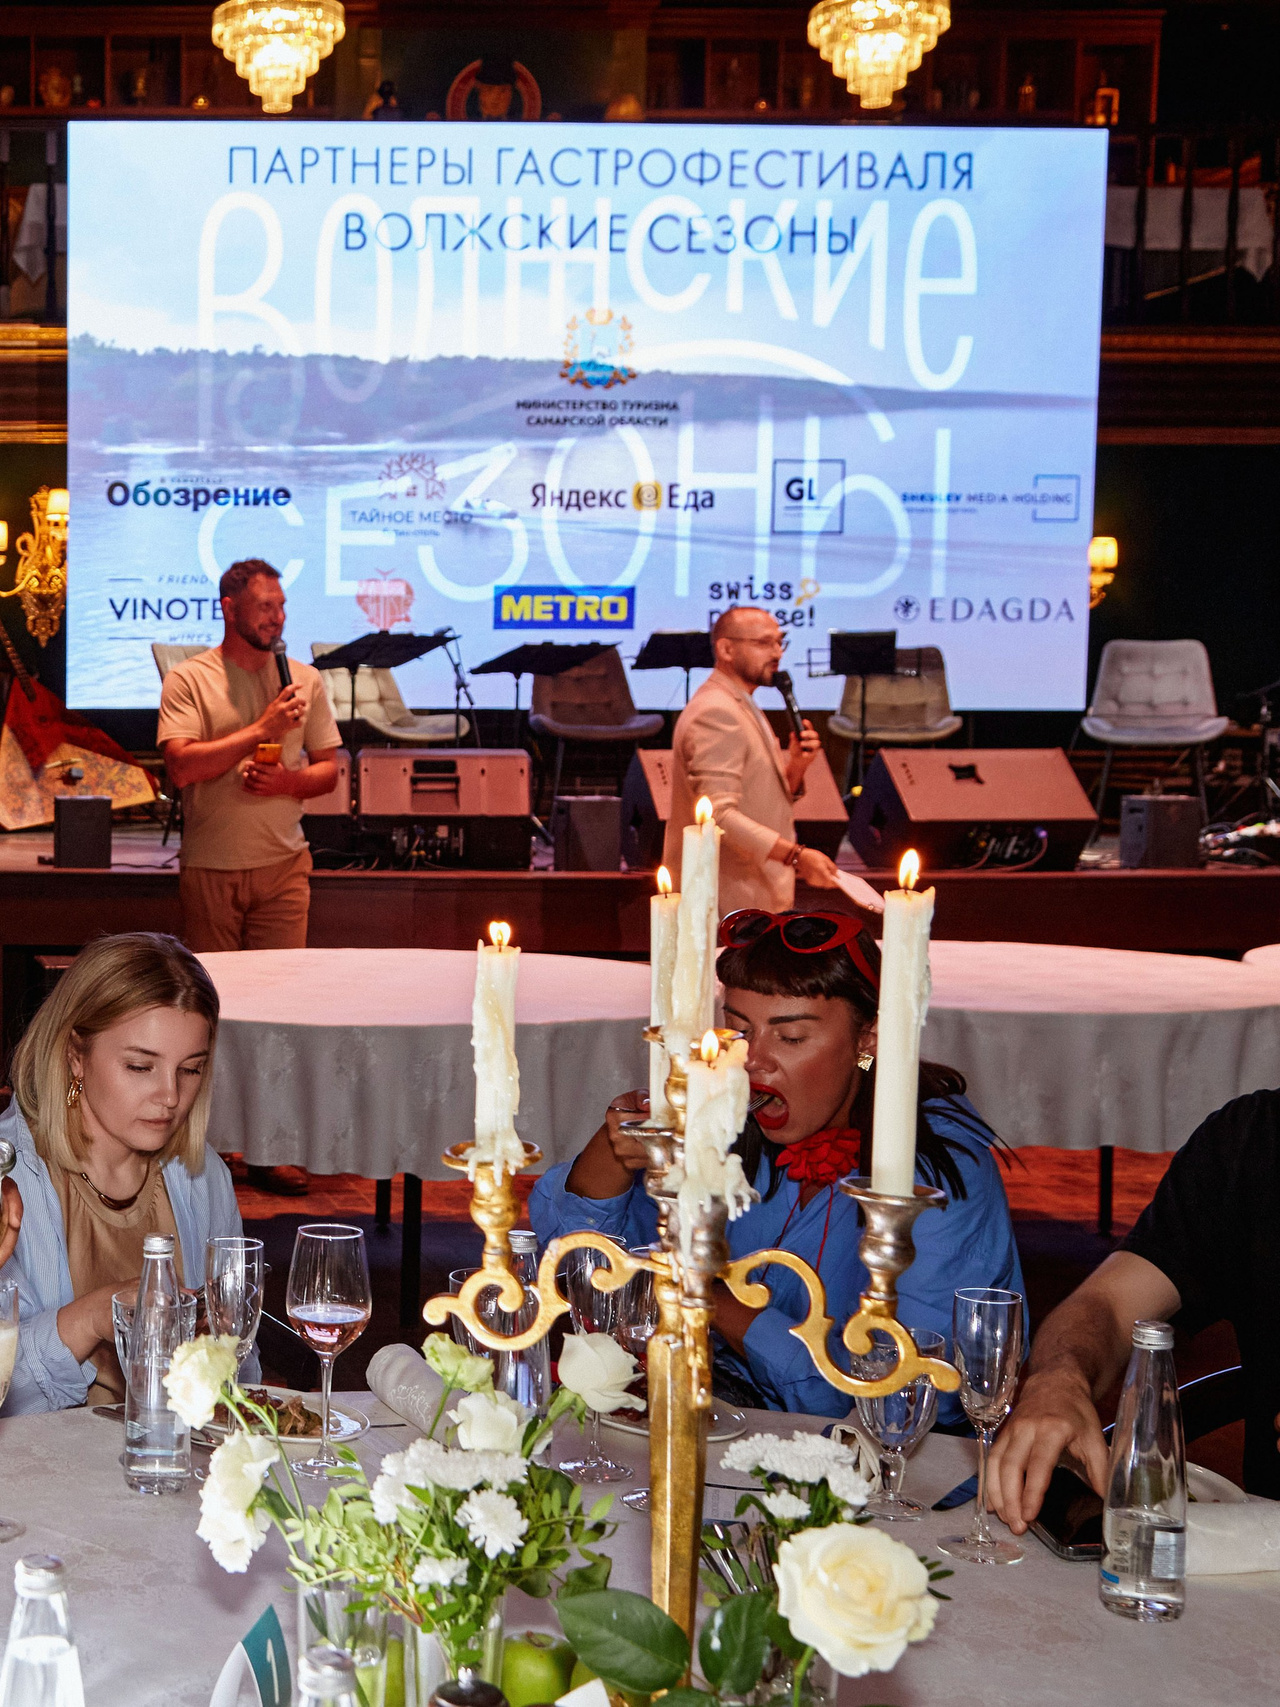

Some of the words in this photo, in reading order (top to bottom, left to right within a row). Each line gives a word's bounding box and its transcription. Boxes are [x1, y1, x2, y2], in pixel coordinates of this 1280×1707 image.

[228, 146, 474, 186] ПАРТНЕРЫ
[496, 147, 975, 191] ГАСТРОФЕСТИВАЛЯ
[344, 212, 629, 253] ВОЛЖСКИЕ
[648, 214, 858, 256] СЕЗОНЫ
[516, 400, 618, 411] МИНИСТЕРСТВО
[622, 401, 680, 412] ТУРИЗМА
[526, 414, 605, 426] САМАРСКОЙ
[609, 416, 669, 427] ОБЛАСТИ
[107, 480, 292, 511] Обозрение
[531, 483, 627, 511] Яндекс
[668, 484, 715, 511] Еда
[786, 478, 815, 501] GL
[350, 509, 414, 523] ТАЙНОЕ
[420, 511, 474, 524] МЕСТО
[709, 575, 792, 600] swiss
[501, 595, 628, 621] METRO
[930, 597, 1075, 622] EDAGDA
[266, 1638, 279, 1706] 1
